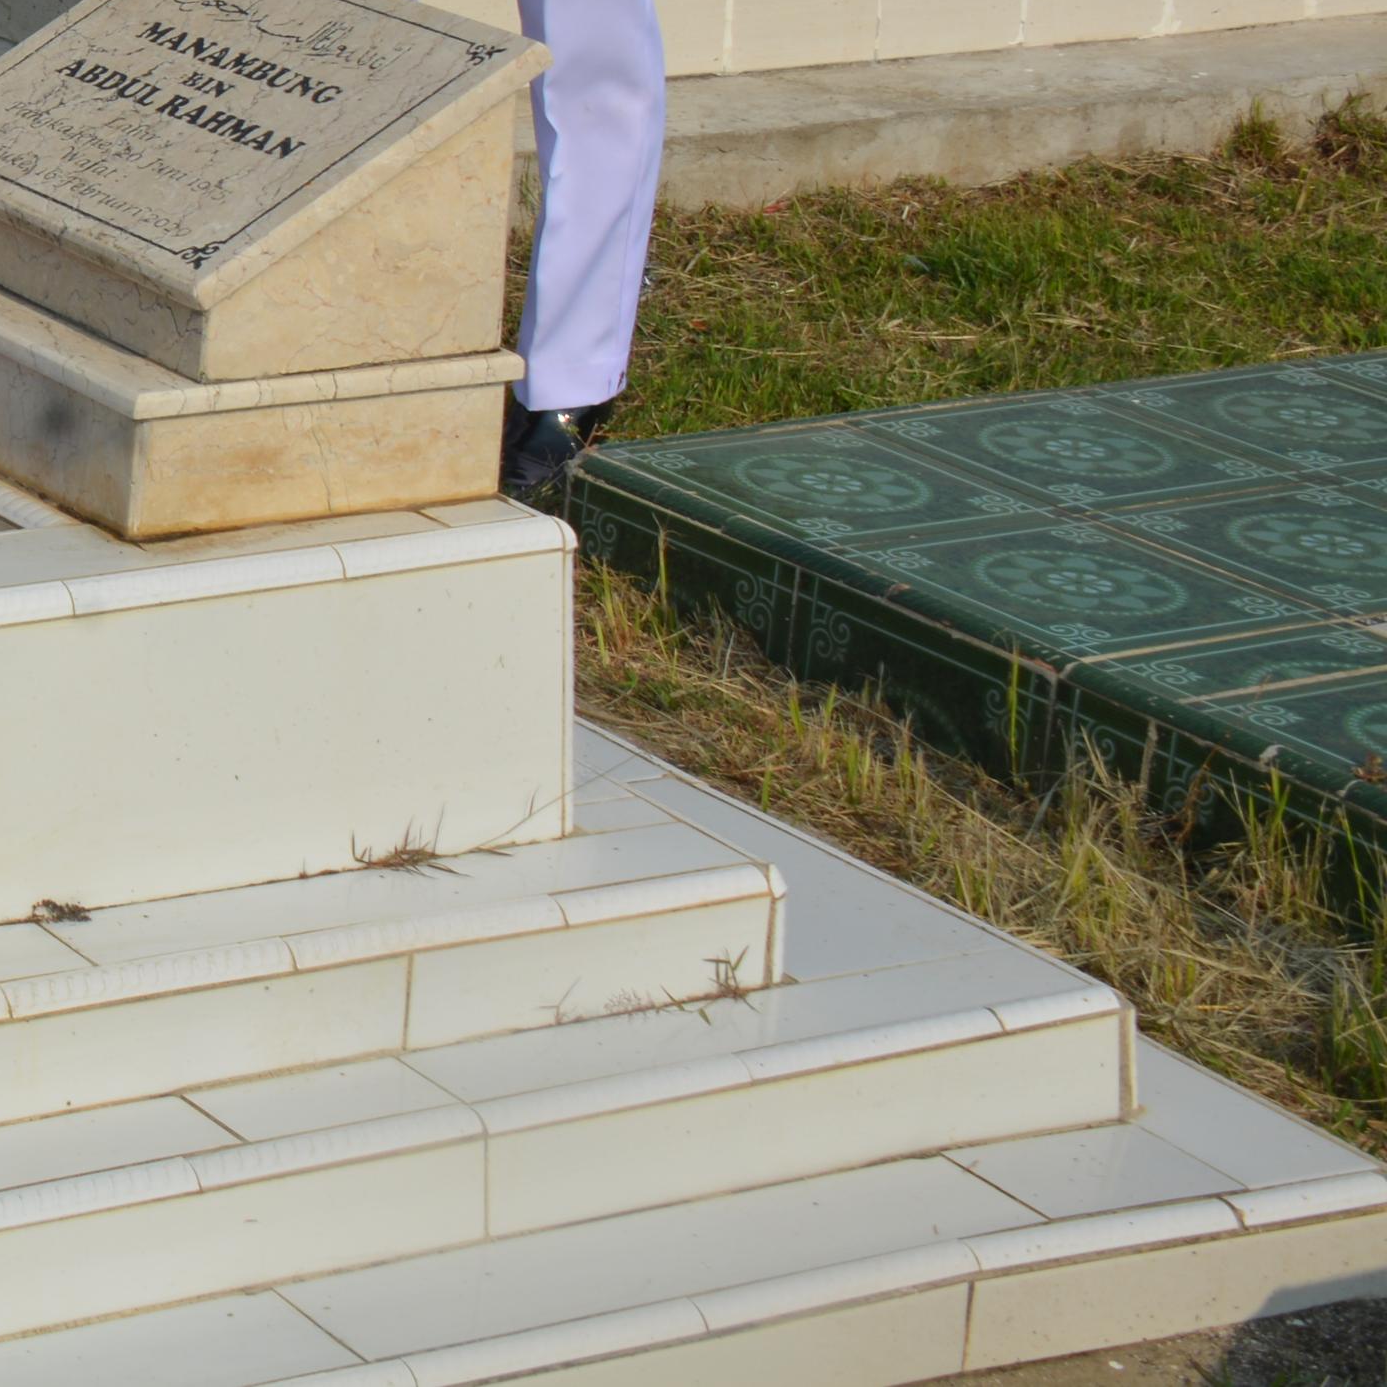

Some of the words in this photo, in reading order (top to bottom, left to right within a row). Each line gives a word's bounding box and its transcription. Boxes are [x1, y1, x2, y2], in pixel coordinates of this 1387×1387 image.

[135, 21, 343, 105] MANAMBUNG
[179, 71, 234, 98] BIN
[55, 57, 167, 107] ABDUL
[155, 94, 306, 160] RAHMAN
[103, 117, 161, 143] Lahir
[57, 145, 120, 181] Wafat
[141, 155, 193, 184] Juni
[55, 174, 154, 222] Februari
